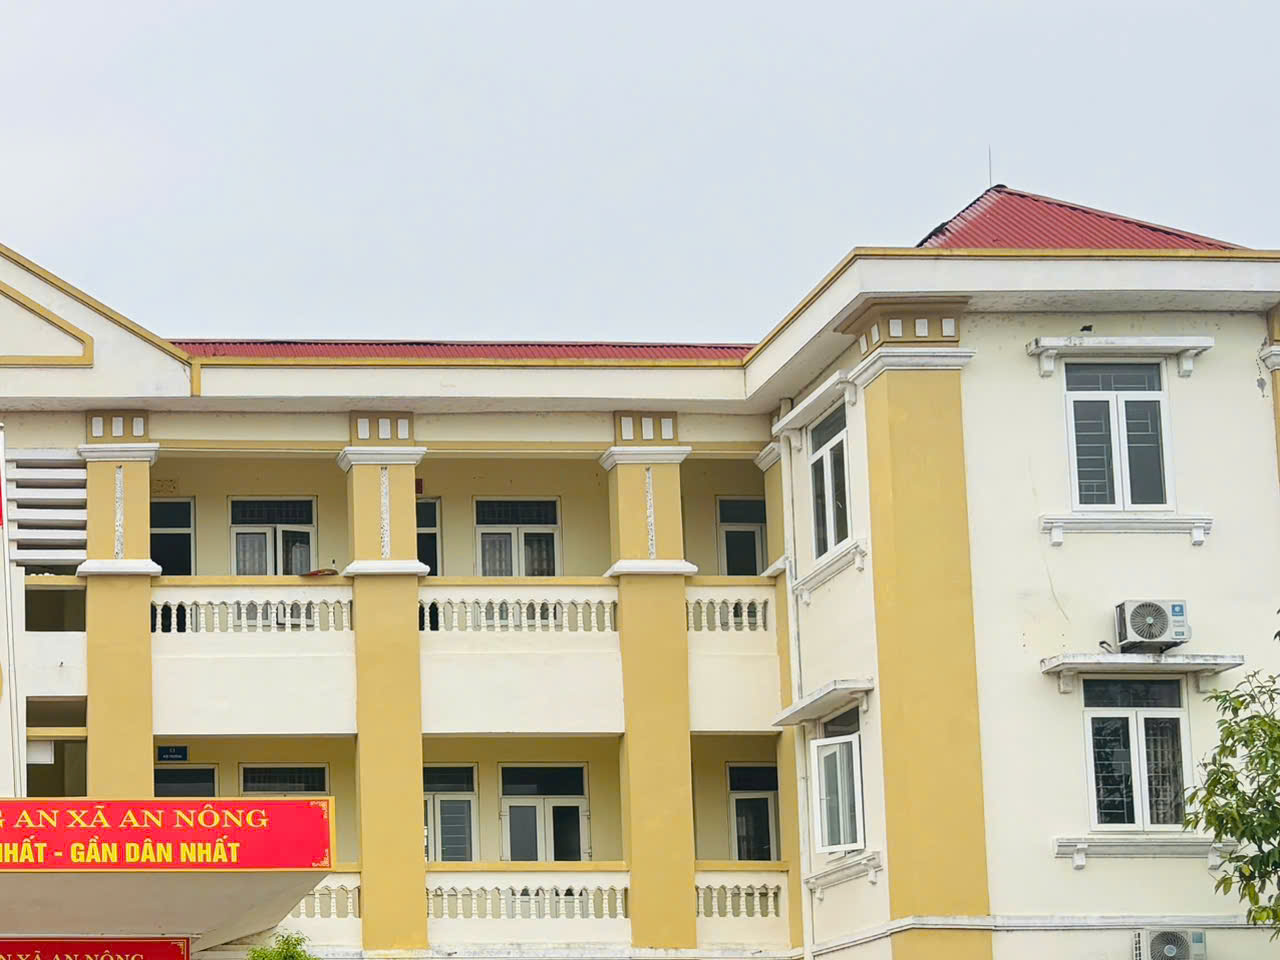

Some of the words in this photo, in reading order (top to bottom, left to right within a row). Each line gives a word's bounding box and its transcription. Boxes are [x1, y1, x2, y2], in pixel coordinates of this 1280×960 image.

[13, 809, 58, 828] AN
[66, 805, 111, 828] XÃ
[119, 809, 164, 828] AN
[173, 804, 269, 828] NÔNG
[70, 835, 118, 864] GẦN
[125, 837, 173, 863] DÂN
[180, 834, 241, 863] NHẤT
